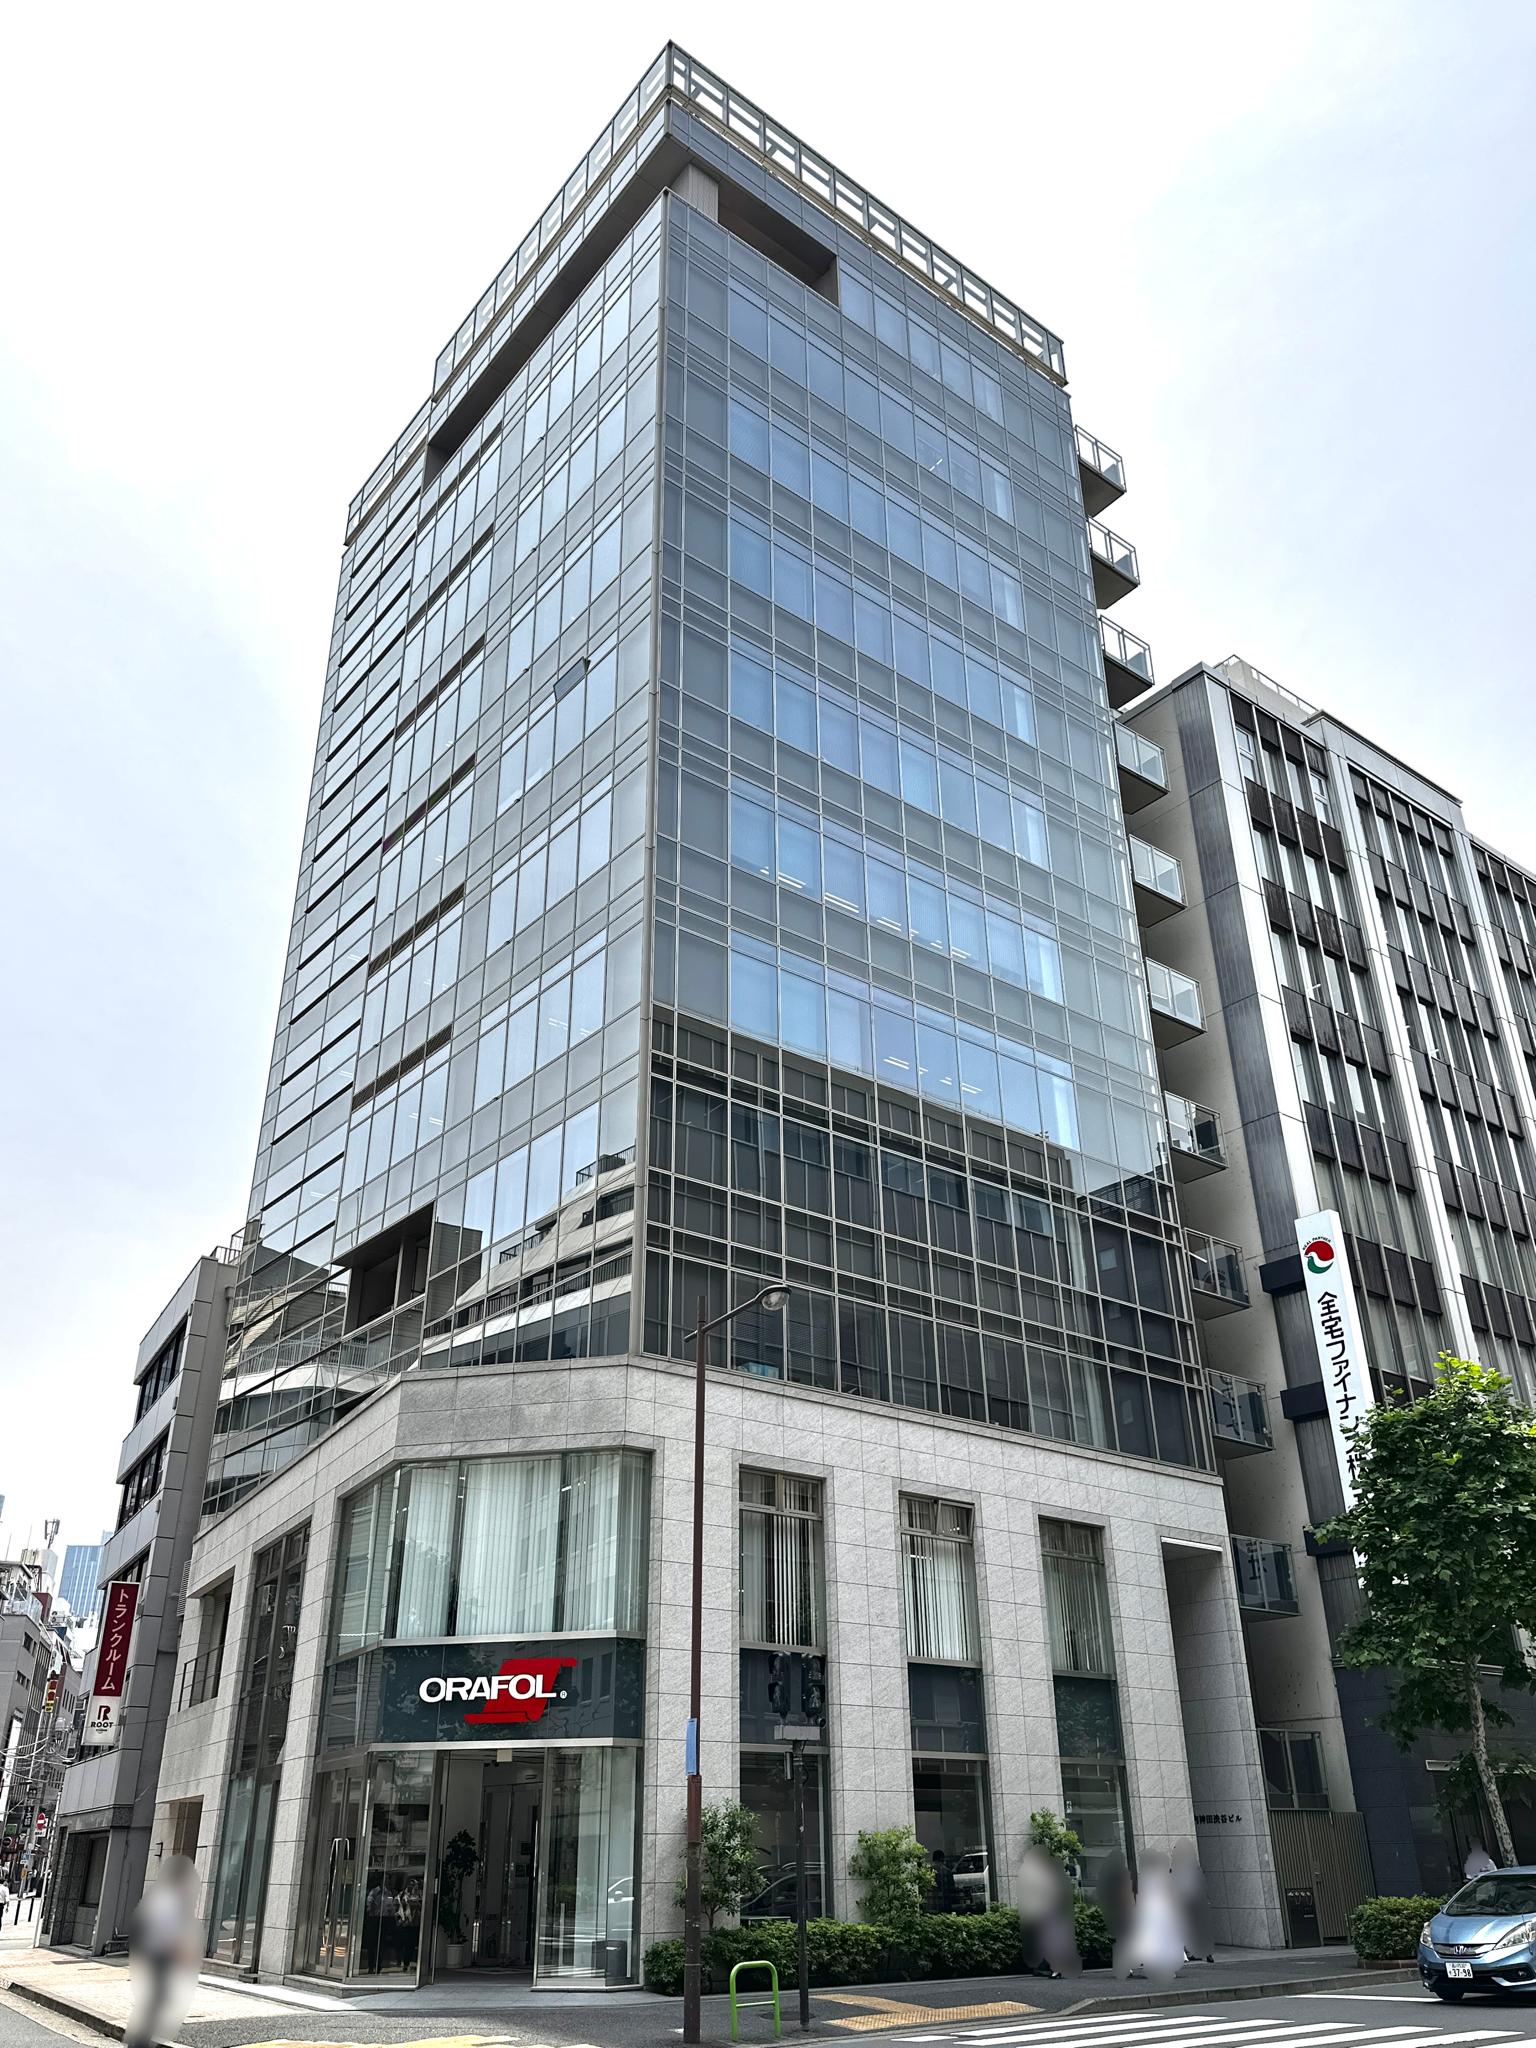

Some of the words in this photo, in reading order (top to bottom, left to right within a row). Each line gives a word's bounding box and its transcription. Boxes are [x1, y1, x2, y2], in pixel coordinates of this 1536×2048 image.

[101, 1588, 129, 1691] トランクルーム
[419, 1674, 557, 1703] ORAFOL
[91, 1721, 114, 1729] ROOT
